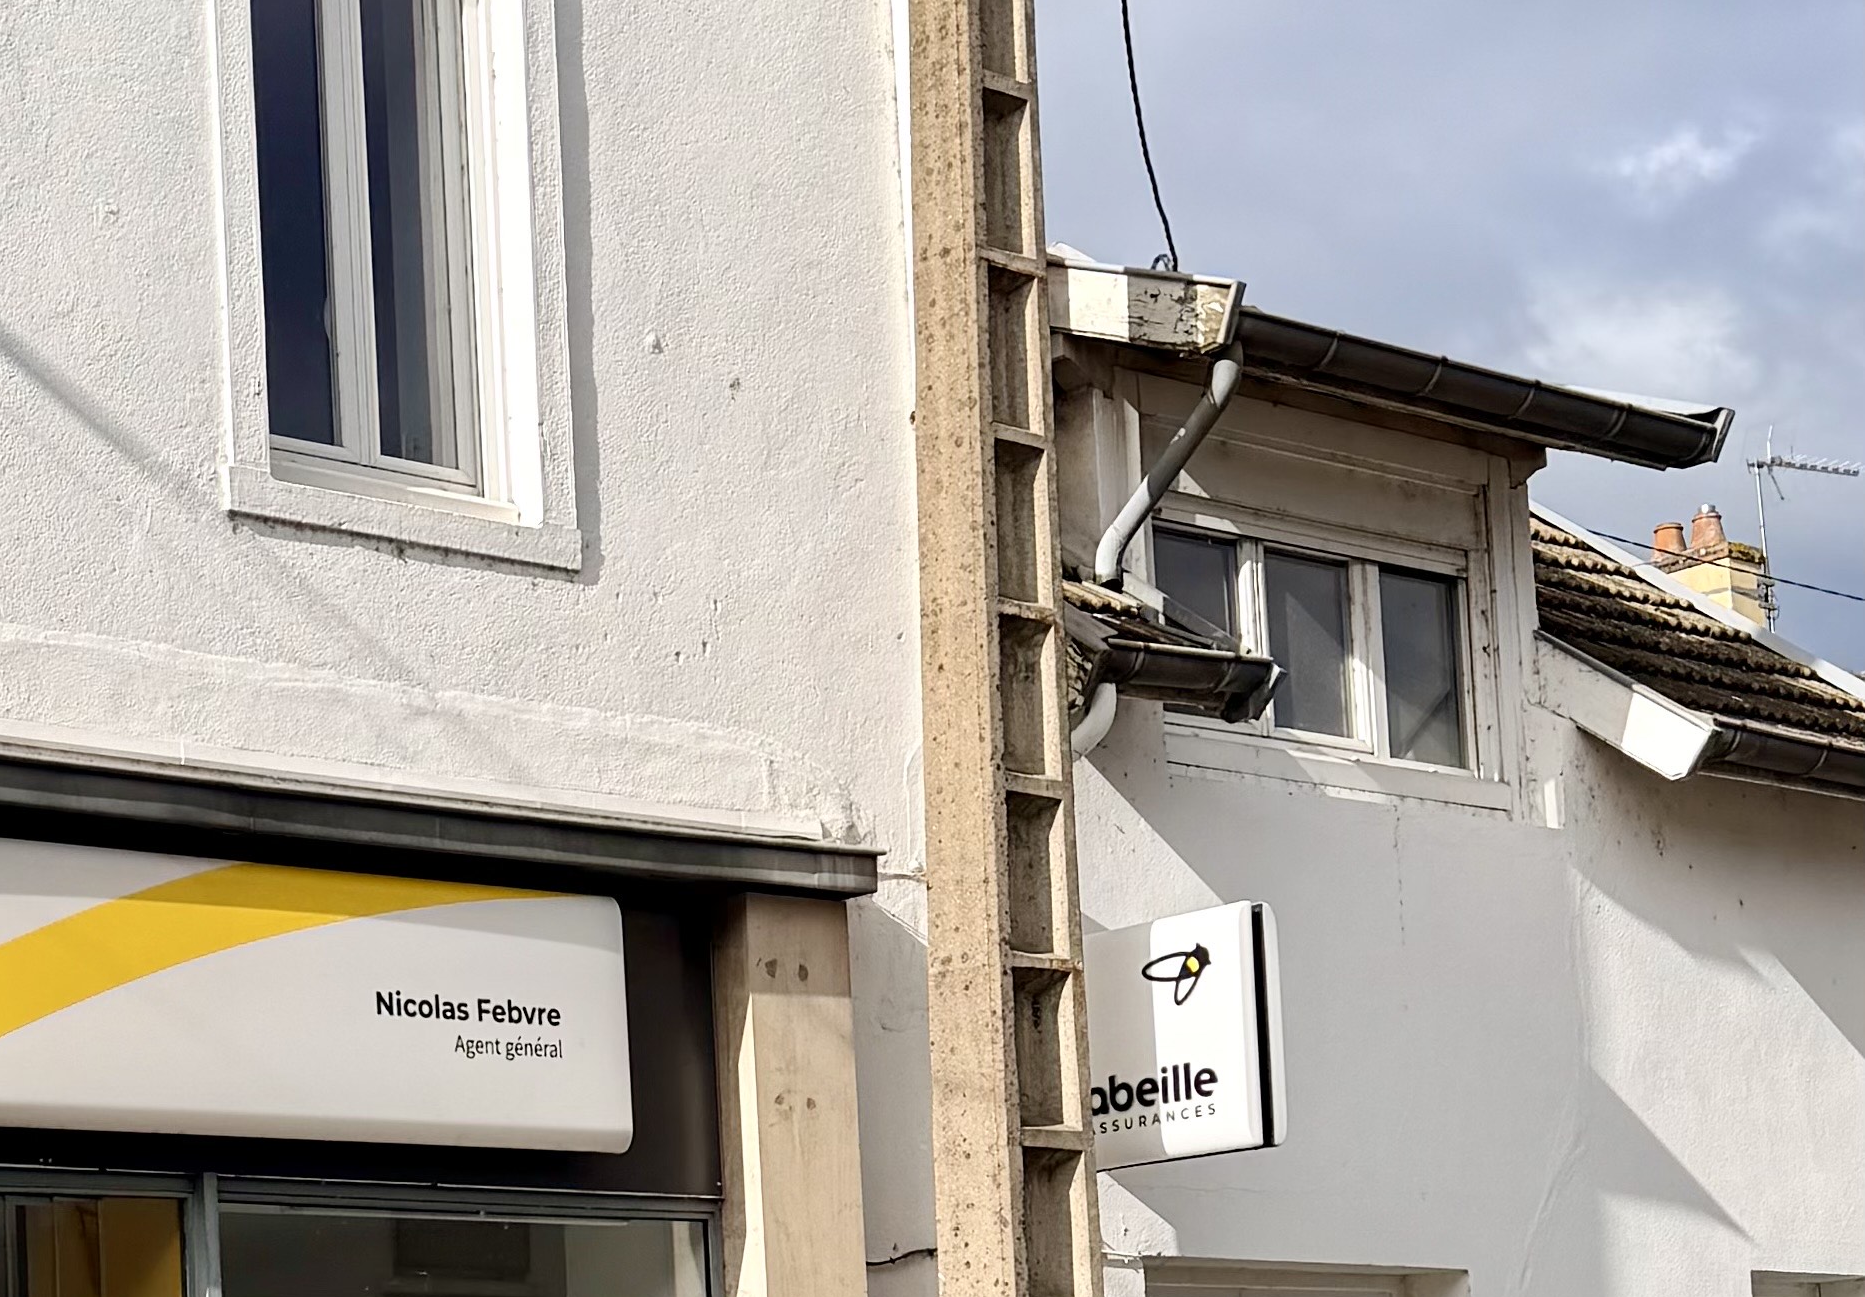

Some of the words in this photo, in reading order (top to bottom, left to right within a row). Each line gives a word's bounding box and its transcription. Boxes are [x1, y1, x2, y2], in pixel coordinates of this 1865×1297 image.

[376, 990, 469, 1021] Nicolas
[477, 999, 561, 1026] Febvre
[455, 1035, 501, 1059] Agent
[505, 1036, 563, 1061] général
[1090, 1062, 1218, 1116] abeille
